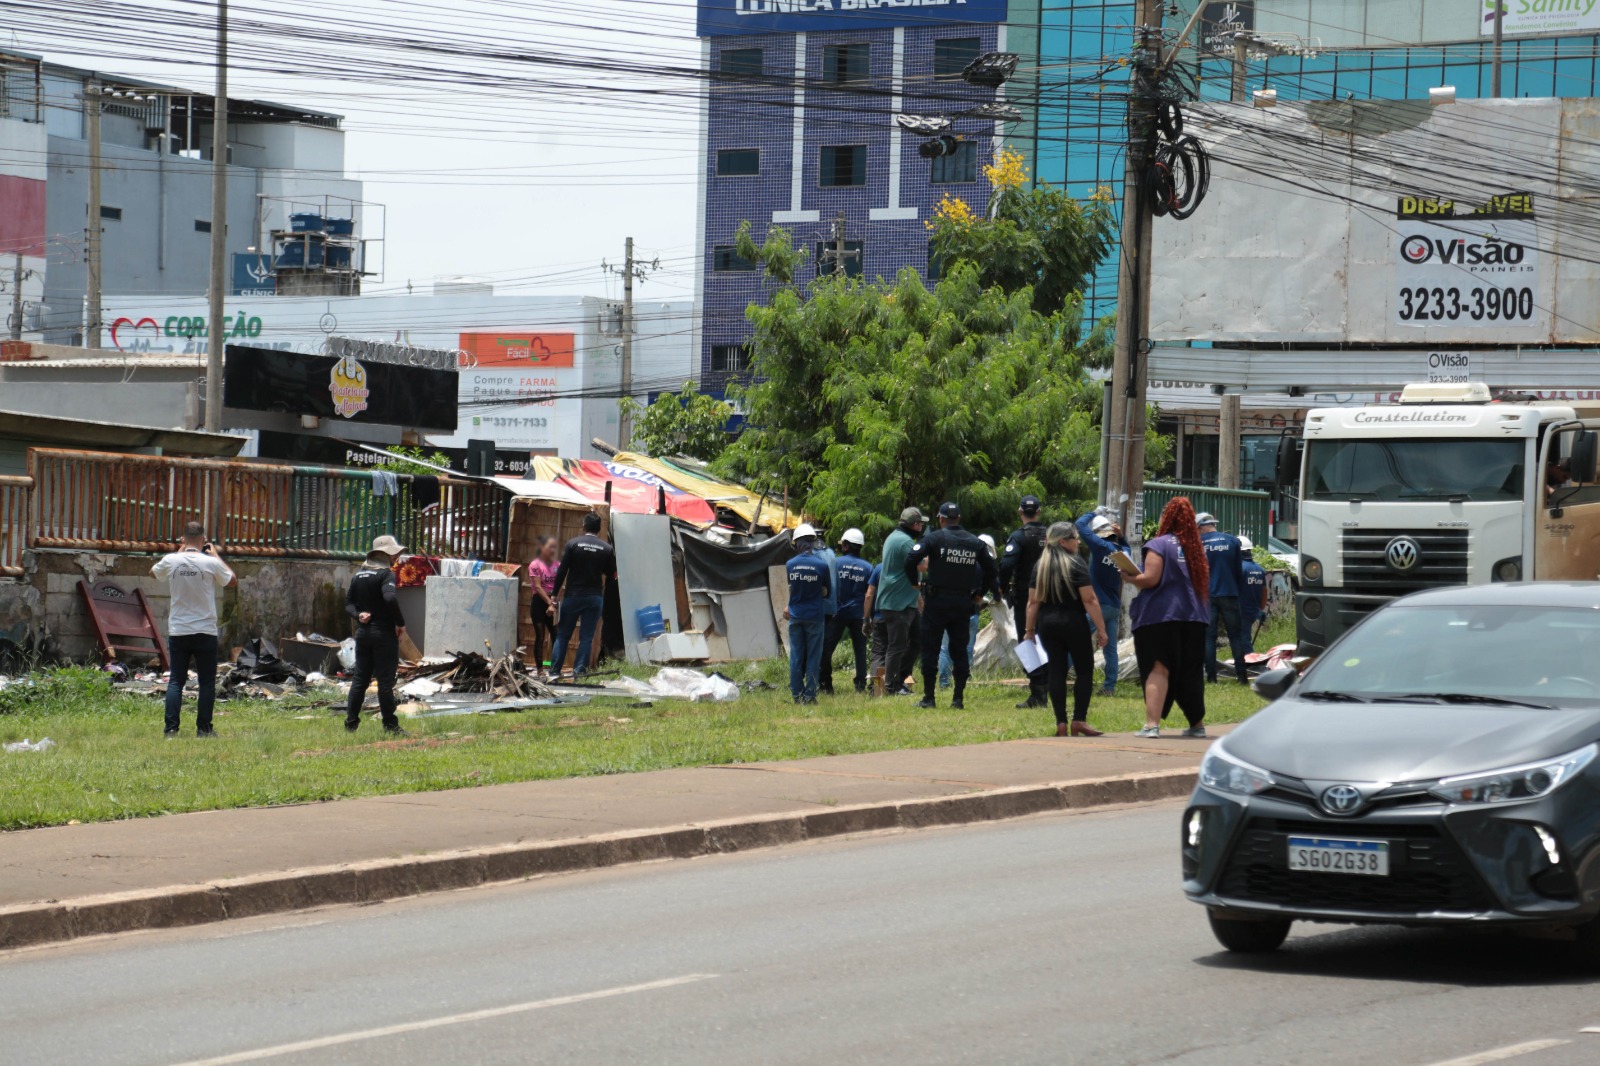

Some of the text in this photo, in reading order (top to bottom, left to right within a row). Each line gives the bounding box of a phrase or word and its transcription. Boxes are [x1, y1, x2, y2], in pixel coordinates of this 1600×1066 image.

[1212, 22, 1245, 31] CONTEX
[1504, 20, 1577, 31] Atendemos Convênios
[1399, 287, 1533, 320] 3233-3900
[497, 337, 529, 347] Farma
[474, 375, 513, 385] Compre
[520, 377, 556, 386] FARMA
[473, 386, 511, 396] Pague
[494, 417, 547, 427] 3371-7133
[1355, 411, 1466, 423] Constellation
[346, 450, 397, 465] Pastelaria
[947, 549, 976, 558] POLÍCIA
[946, 557, 976, 565] MILITAR
